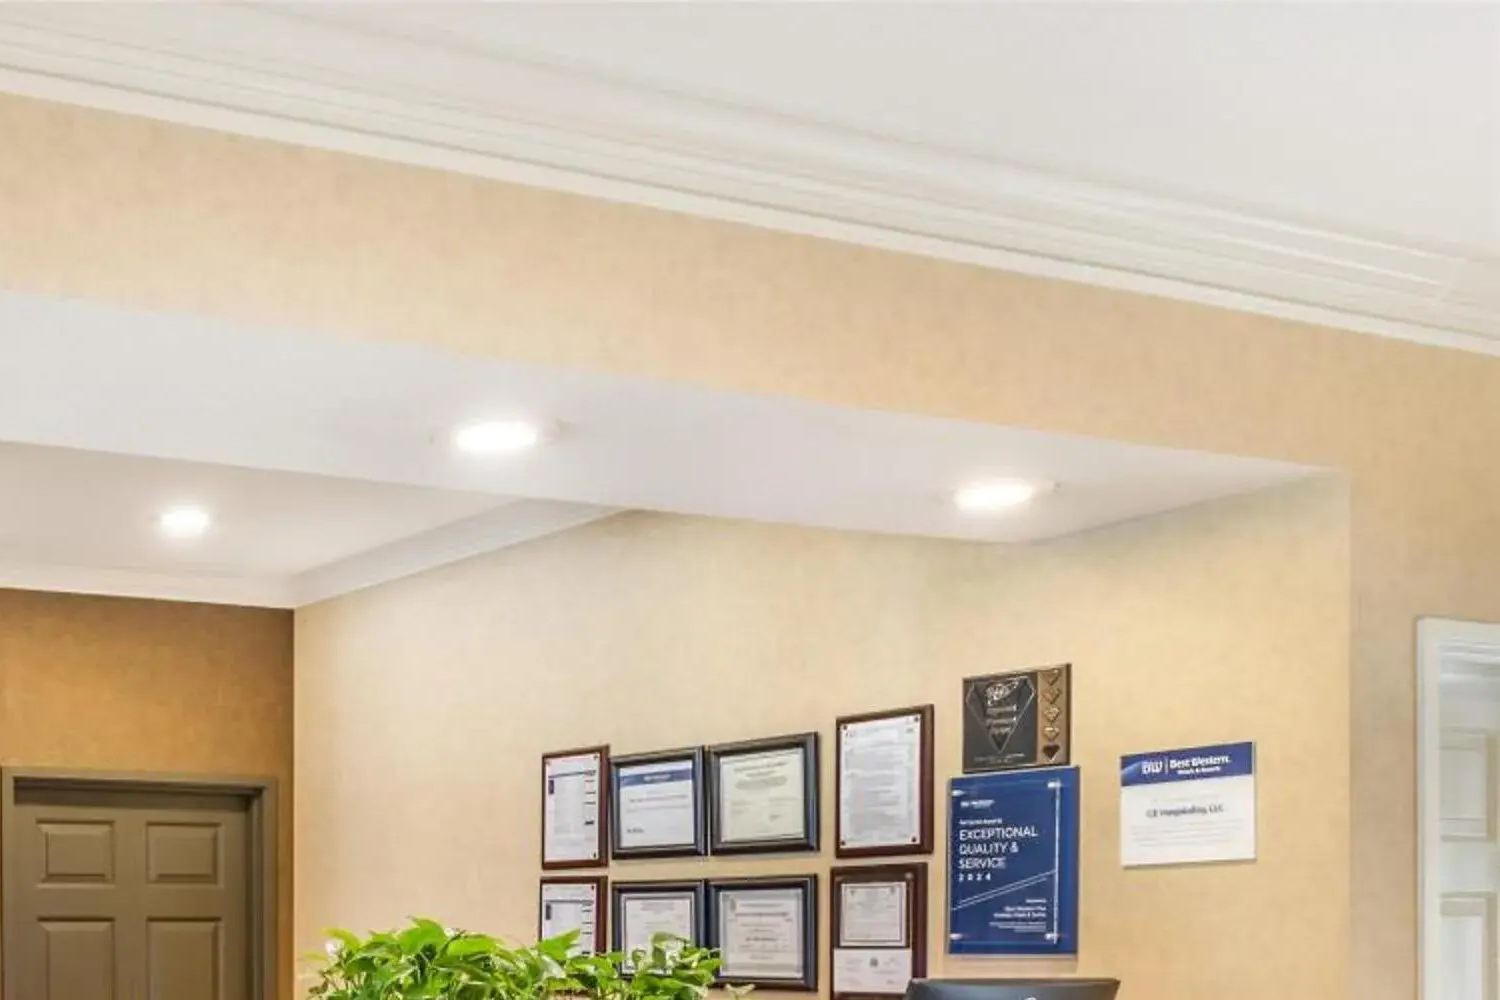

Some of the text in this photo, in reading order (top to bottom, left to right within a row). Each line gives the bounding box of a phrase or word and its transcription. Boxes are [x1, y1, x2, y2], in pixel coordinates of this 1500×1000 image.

[959, 825, 1038, 841] EXCEPTIONAL
[959, 841, 1019, 855] QUALITY &
[959, 857, 1006, 869] SERVICE
